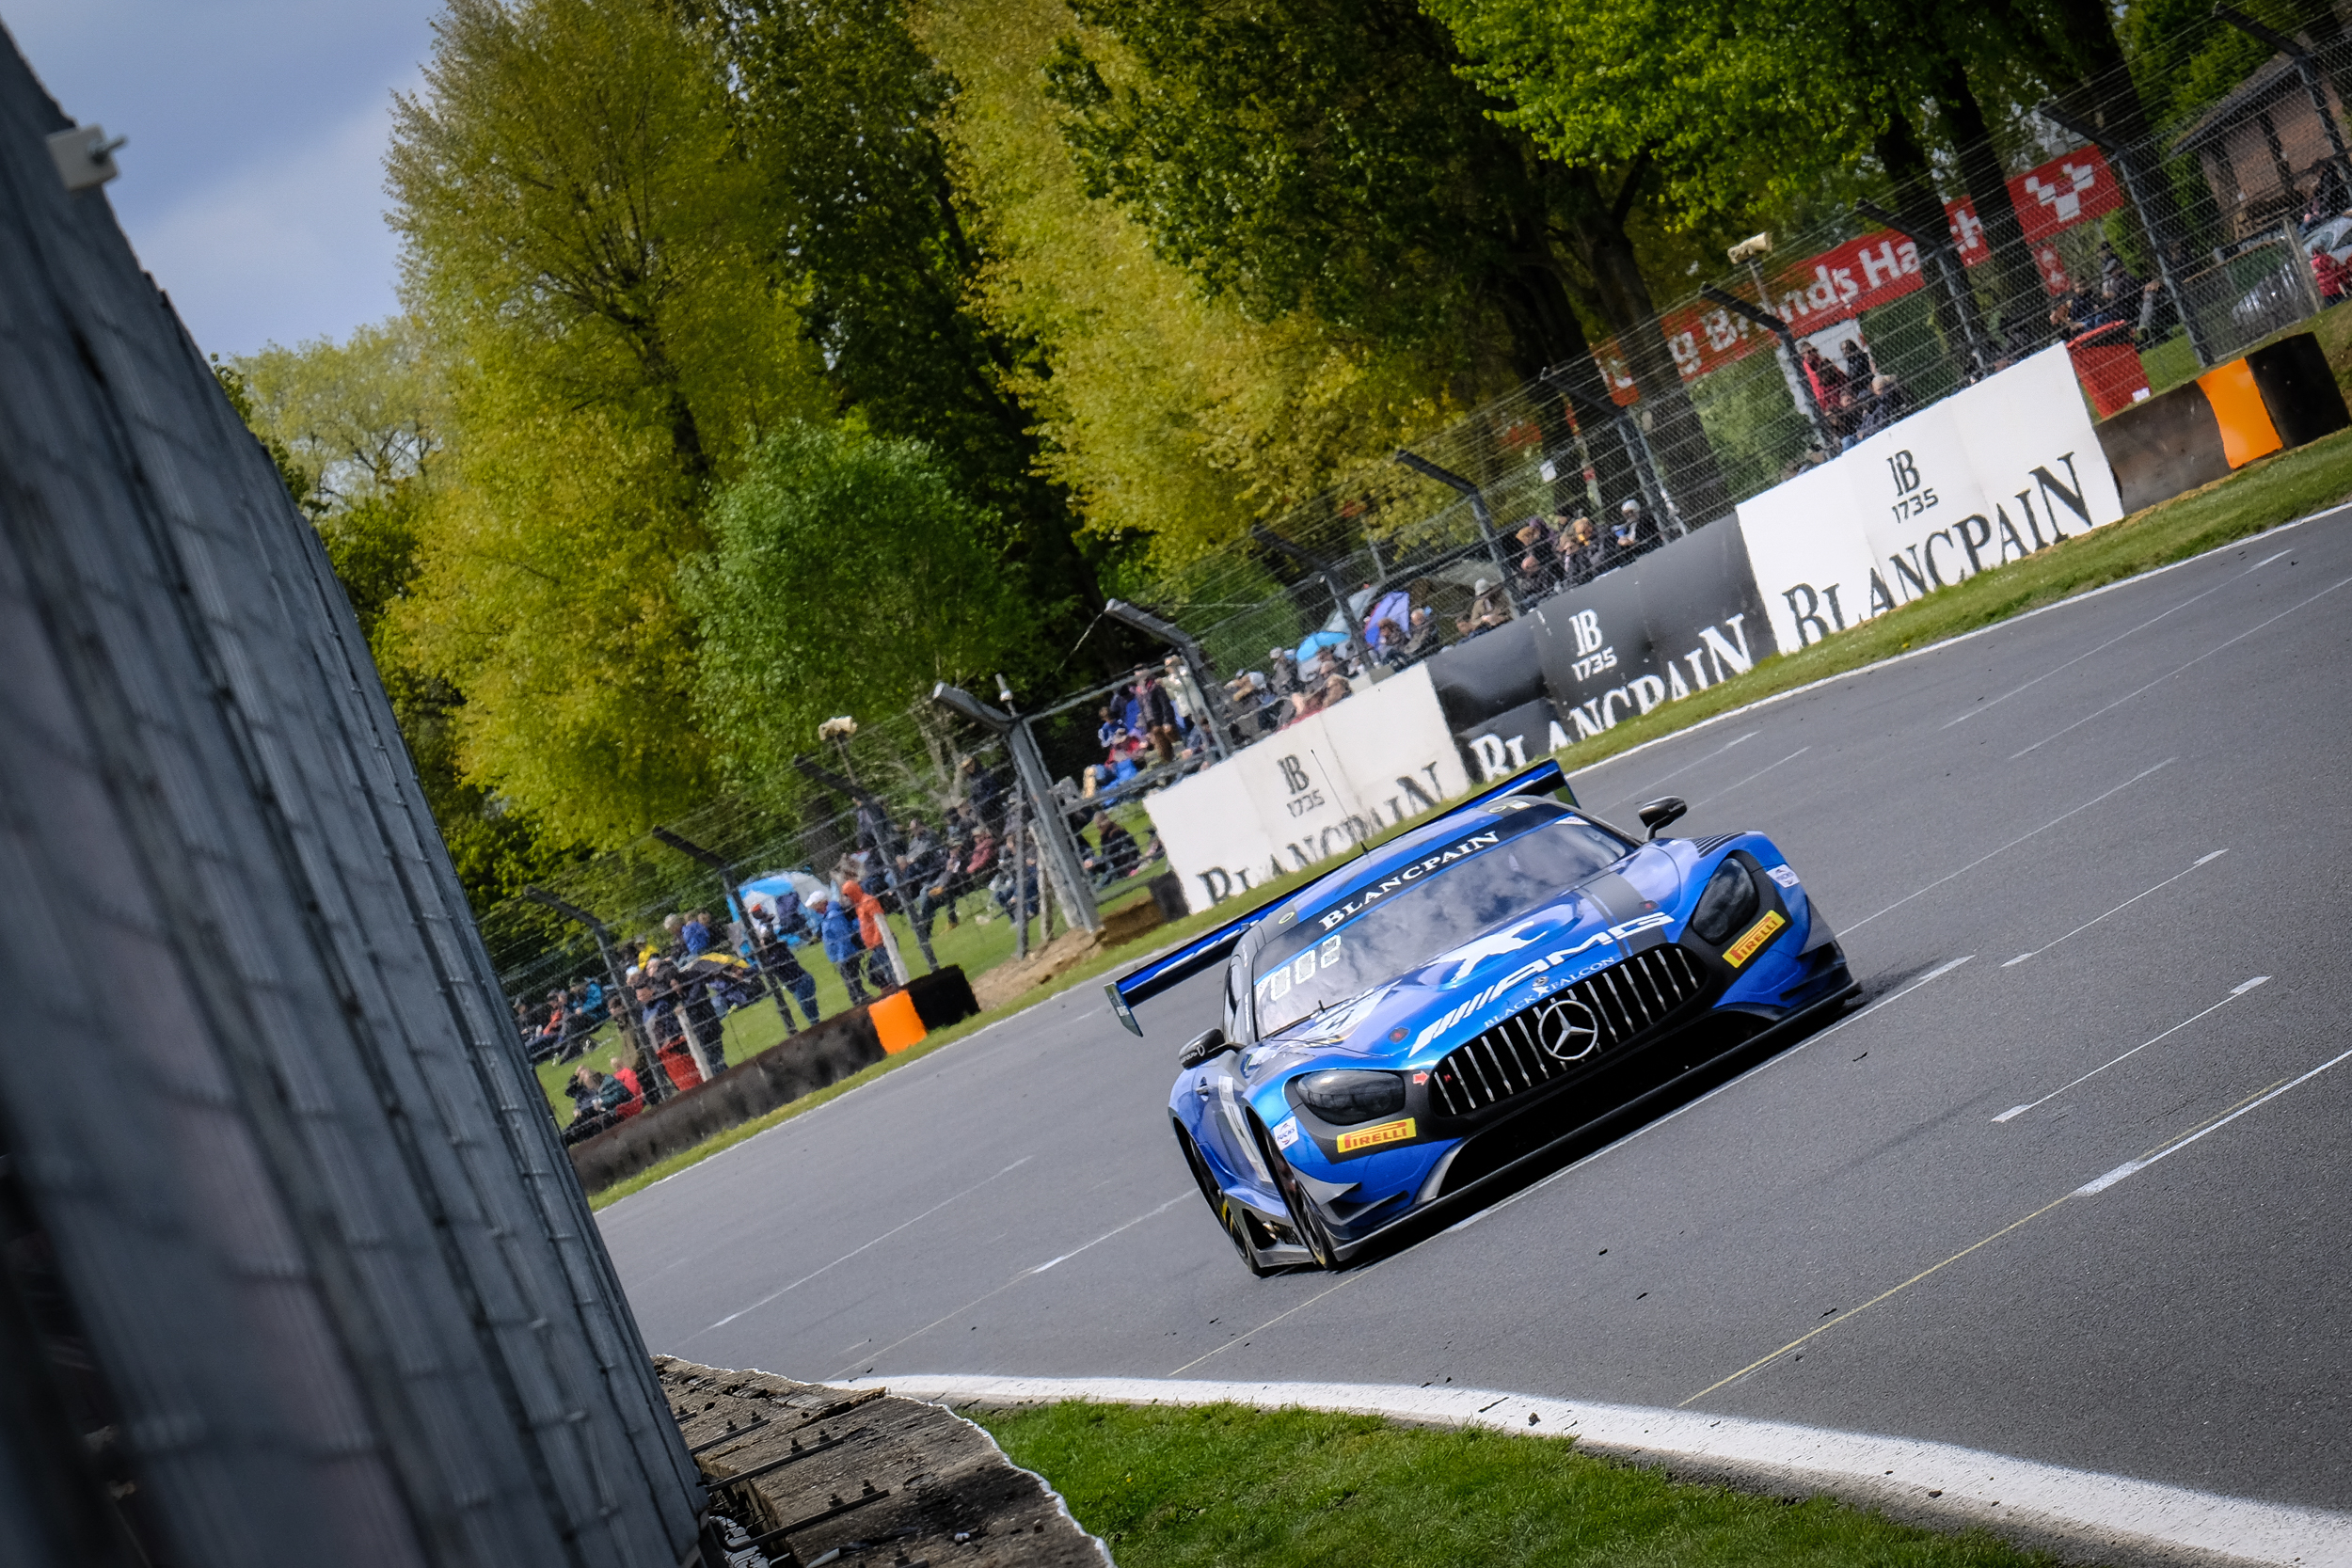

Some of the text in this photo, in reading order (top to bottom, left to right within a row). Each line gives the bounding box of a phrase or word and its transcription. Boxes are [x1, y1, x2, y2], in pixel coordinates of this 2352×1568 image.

[1891, 487, 1939, 524] 1735
[1782, 451, 2093, 647] BLANCPAIN
[1571, 646, 1618, 682] 1735
[1286, 788, 1326, 818] 1735
[1319, 831, 1500, 931] BLANCPAIN
[1488, 911, 1676, 1003] AMG
[1729, 916, 1779, 962] PIRELLI
[1484, 956, 1615, 1028] BLACK FALCON
[1344, 1120, 1407, 1149] PIRELLI
